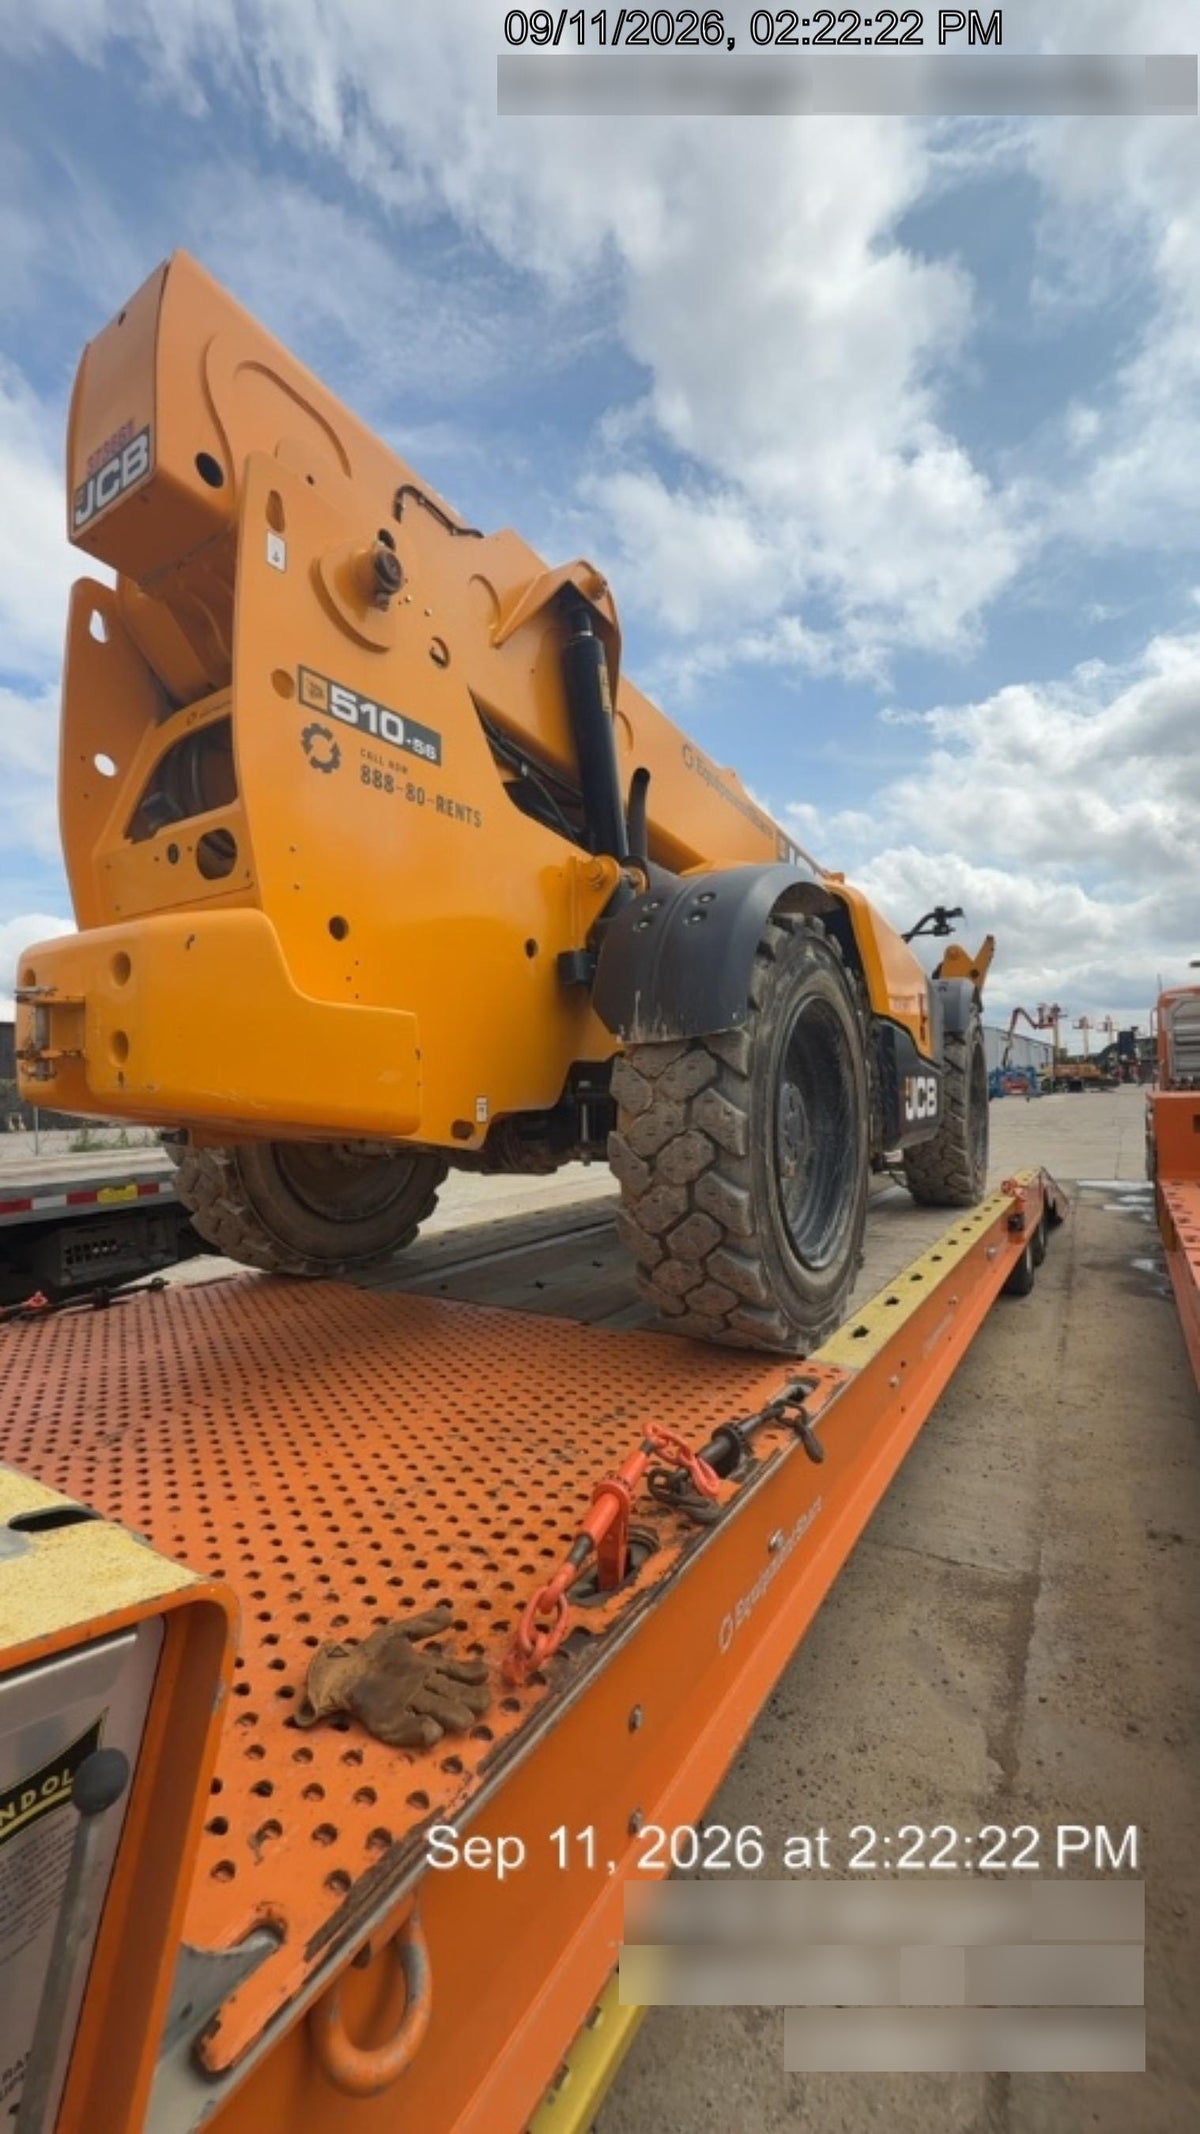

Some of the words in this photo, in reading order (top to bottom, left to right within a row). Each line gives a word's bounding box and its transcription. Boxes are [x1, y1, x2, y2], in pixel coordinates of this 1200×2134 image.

[75, 432, 149, 526] JCB
[360, 747, 385, 767] CALL
[360, 763, 483, 829] 888-80-RENTS
[904, 1075, 938, 1121] JCB
